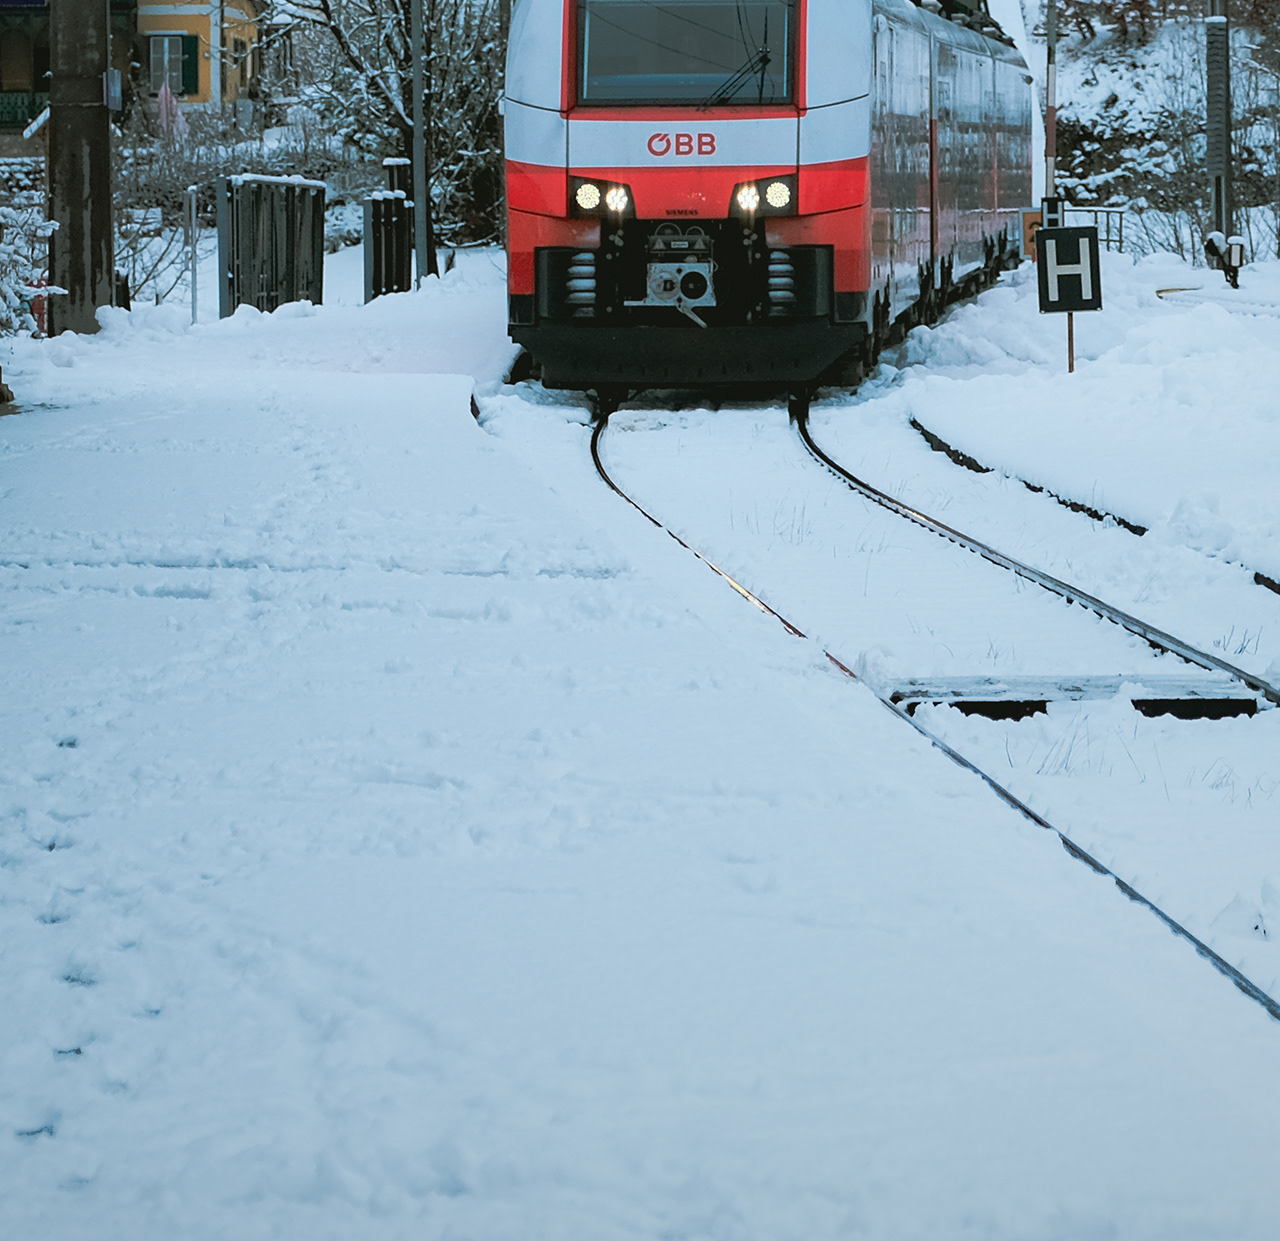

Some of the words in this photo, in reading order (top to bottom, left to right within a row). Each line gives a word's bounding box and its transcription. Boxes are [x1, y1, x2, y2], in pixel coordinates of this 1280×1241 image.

[646, 131, 717, 157] ÖBB
[665, 209, 699, 217] SIEMENS
[1042, 201, 1063, 229] H
[1045, 237, 1093, 302] H
